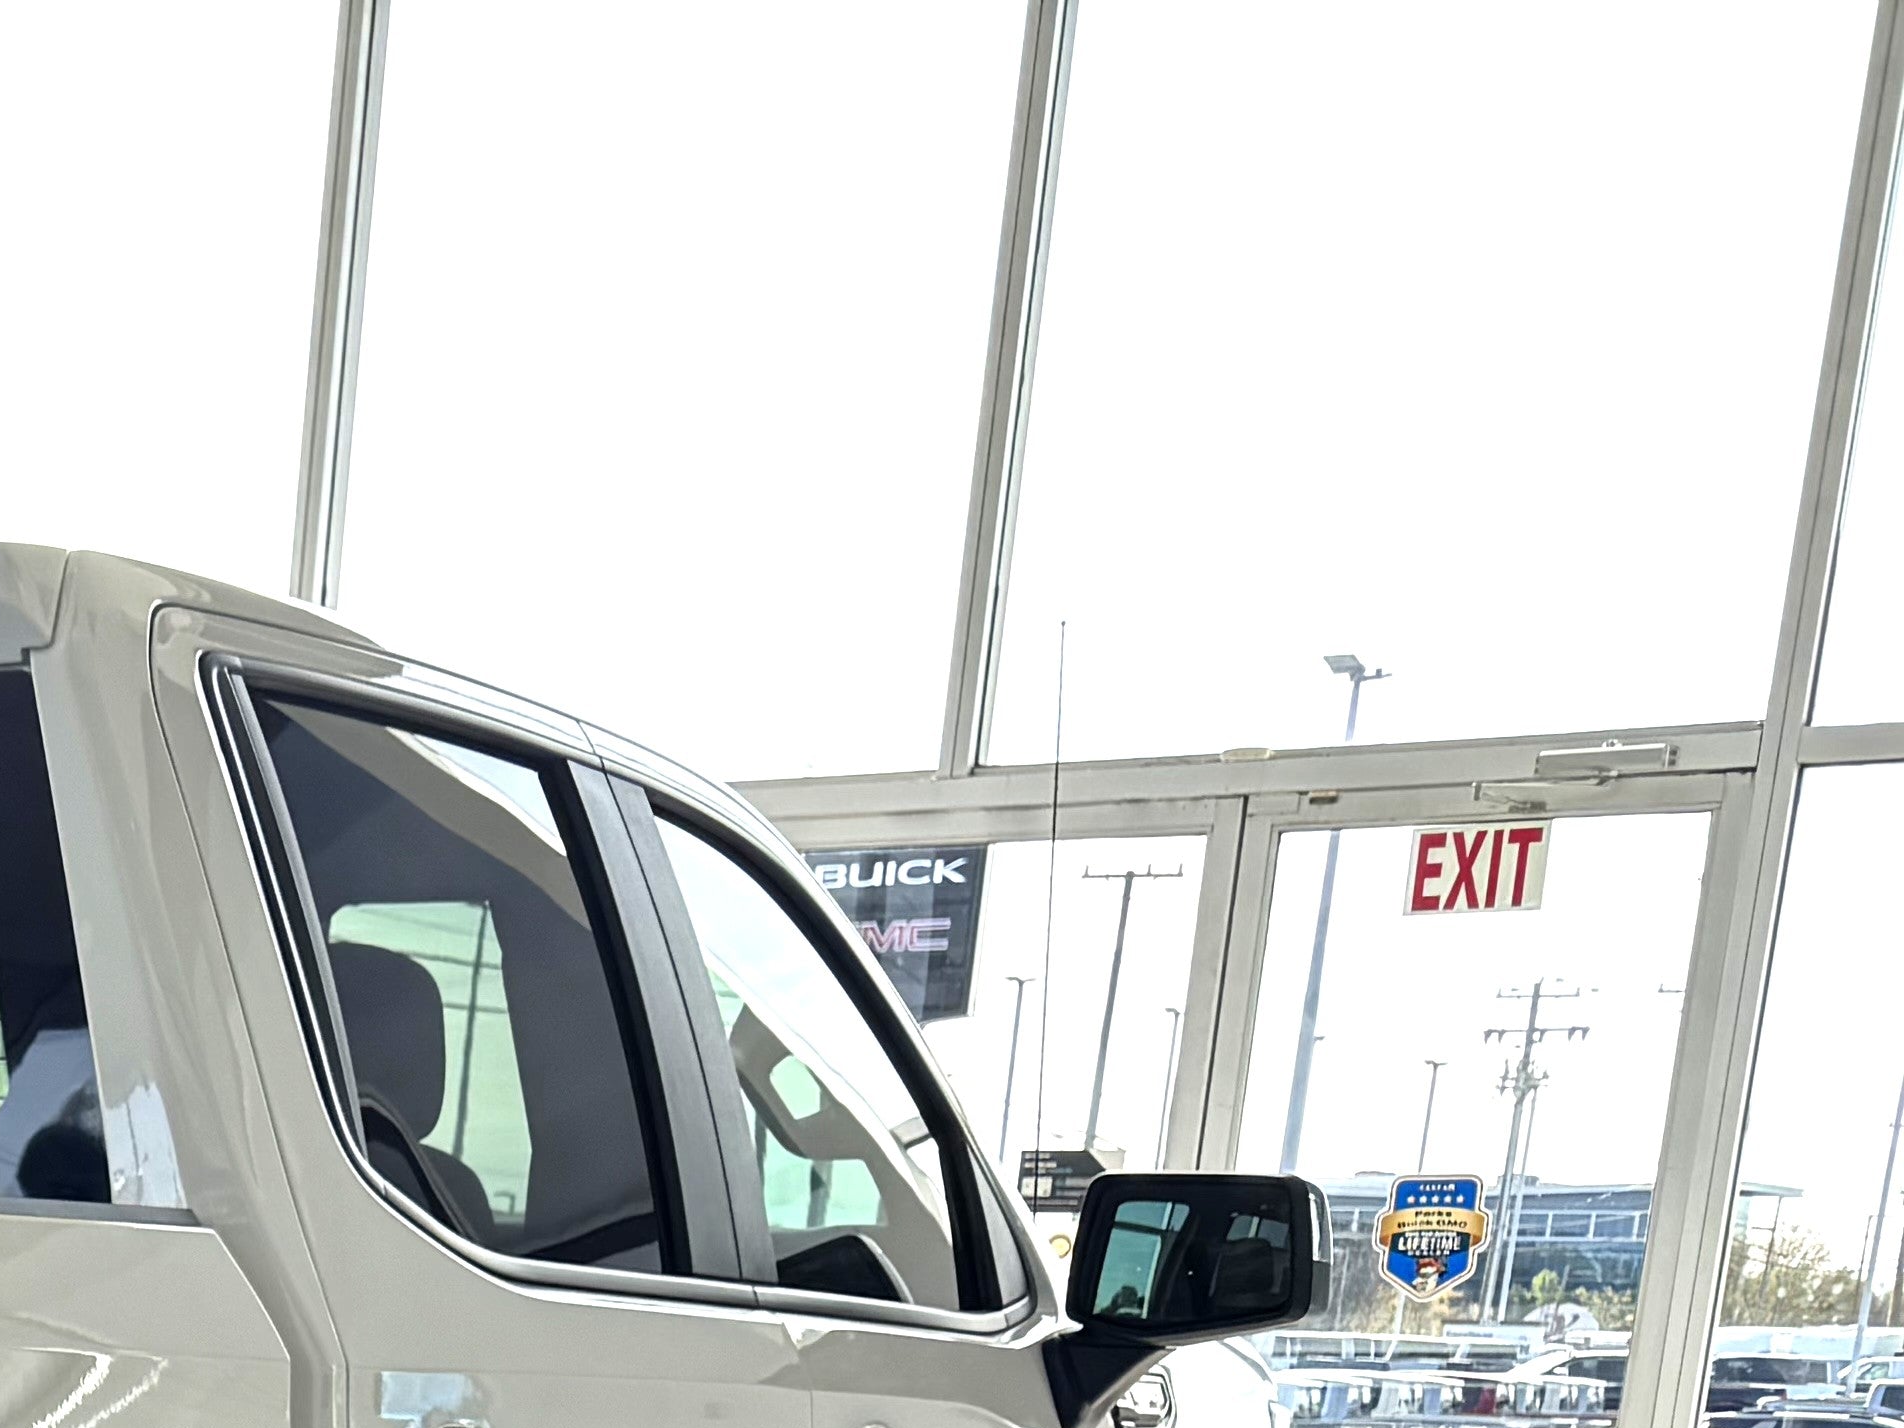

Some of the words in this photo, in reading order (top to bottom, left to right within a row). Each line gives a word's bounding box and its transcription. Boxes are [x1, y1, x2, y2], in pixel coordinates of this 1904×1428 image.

[814, 857, 969, 889] BUICK
[1411, 827, 1544, 912] EXIT
[854, 917, 952, 953] MC
[1397, 1236, 1461, 1251] LIFETIME
